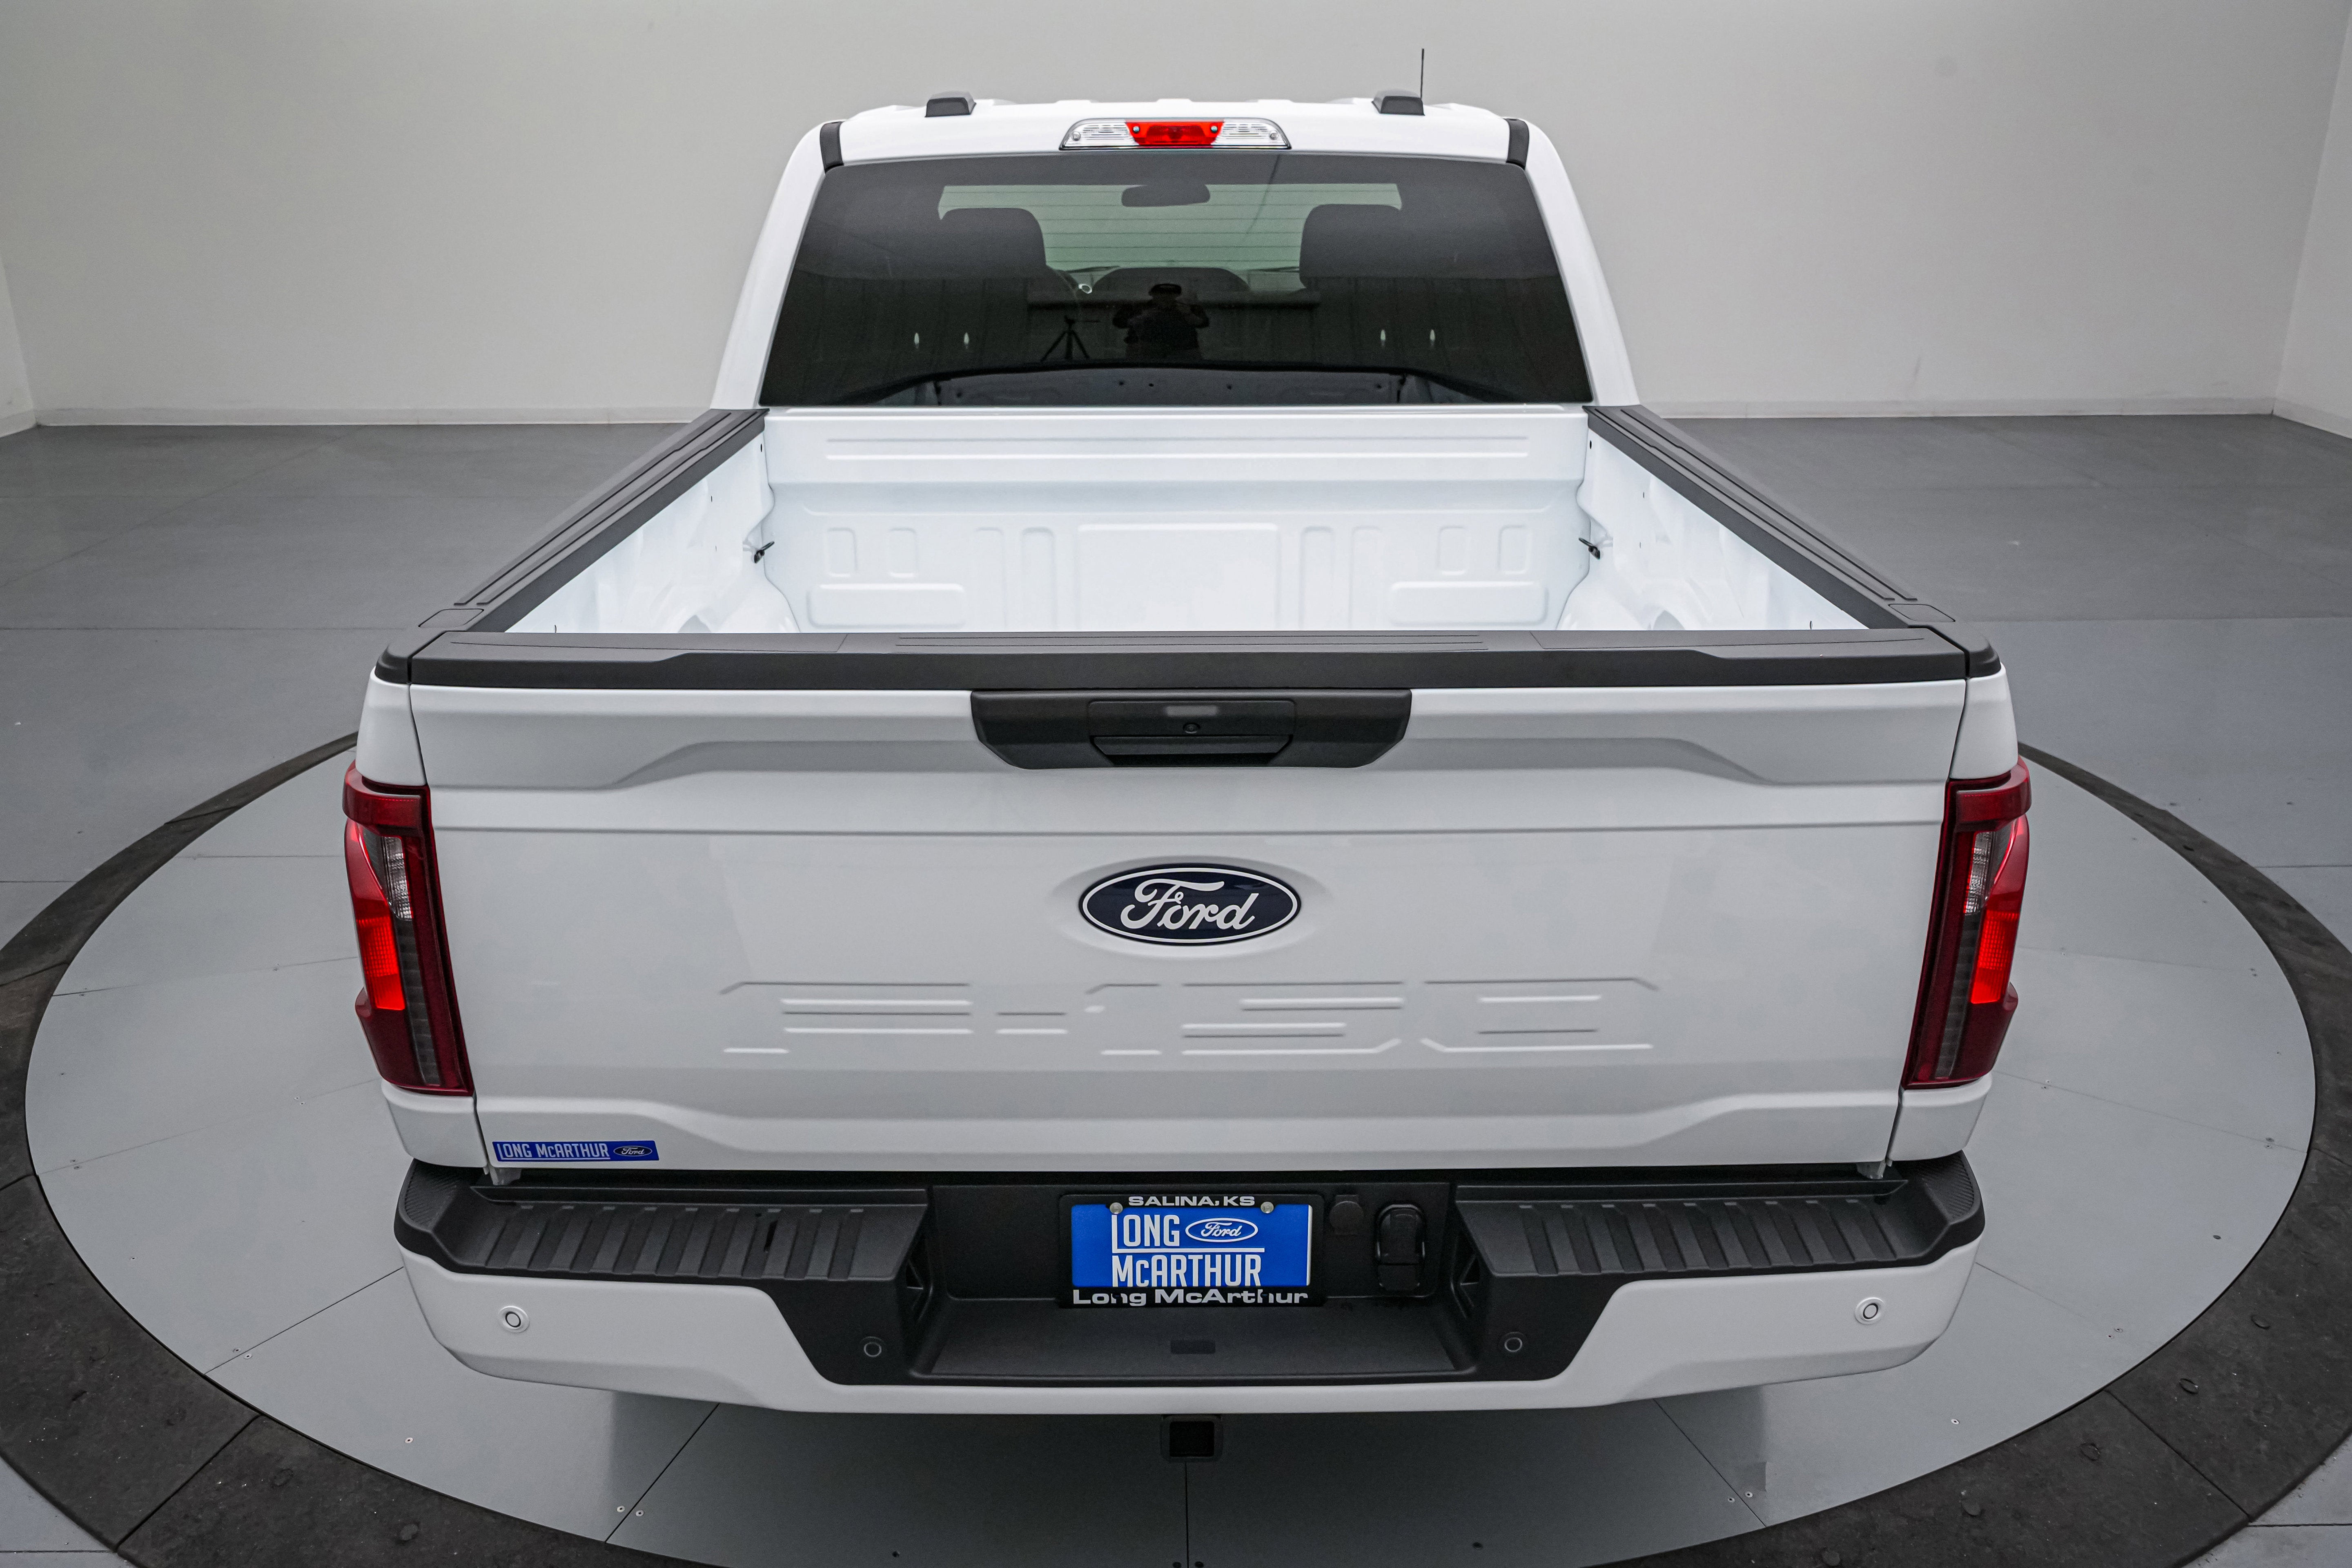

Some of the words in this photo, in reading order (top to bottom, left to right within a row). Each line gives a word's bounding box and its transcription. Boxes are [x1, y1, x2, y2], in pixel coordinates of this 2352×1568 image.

[1120, 878, 1259, 929] Ford
[497, 1143, 532, 1160] LONG
[536, 1143, 610, 1158] McARTHUR
[621, 1147, 645, 1155] Ford
[1128, 1196, 1220, 1206] SALINA,
[1224, 1196, 1255, 1206] KS
[1111, 1214, 1180, 1253] LONG
[1200, 1222, 1241, 1237] Ford
[1111, 1254, 1261, 1287] McARTHUR
[1073, 1289, 1147, 1306] Long
[1155, 1289, 1308, 1303] McArthur
